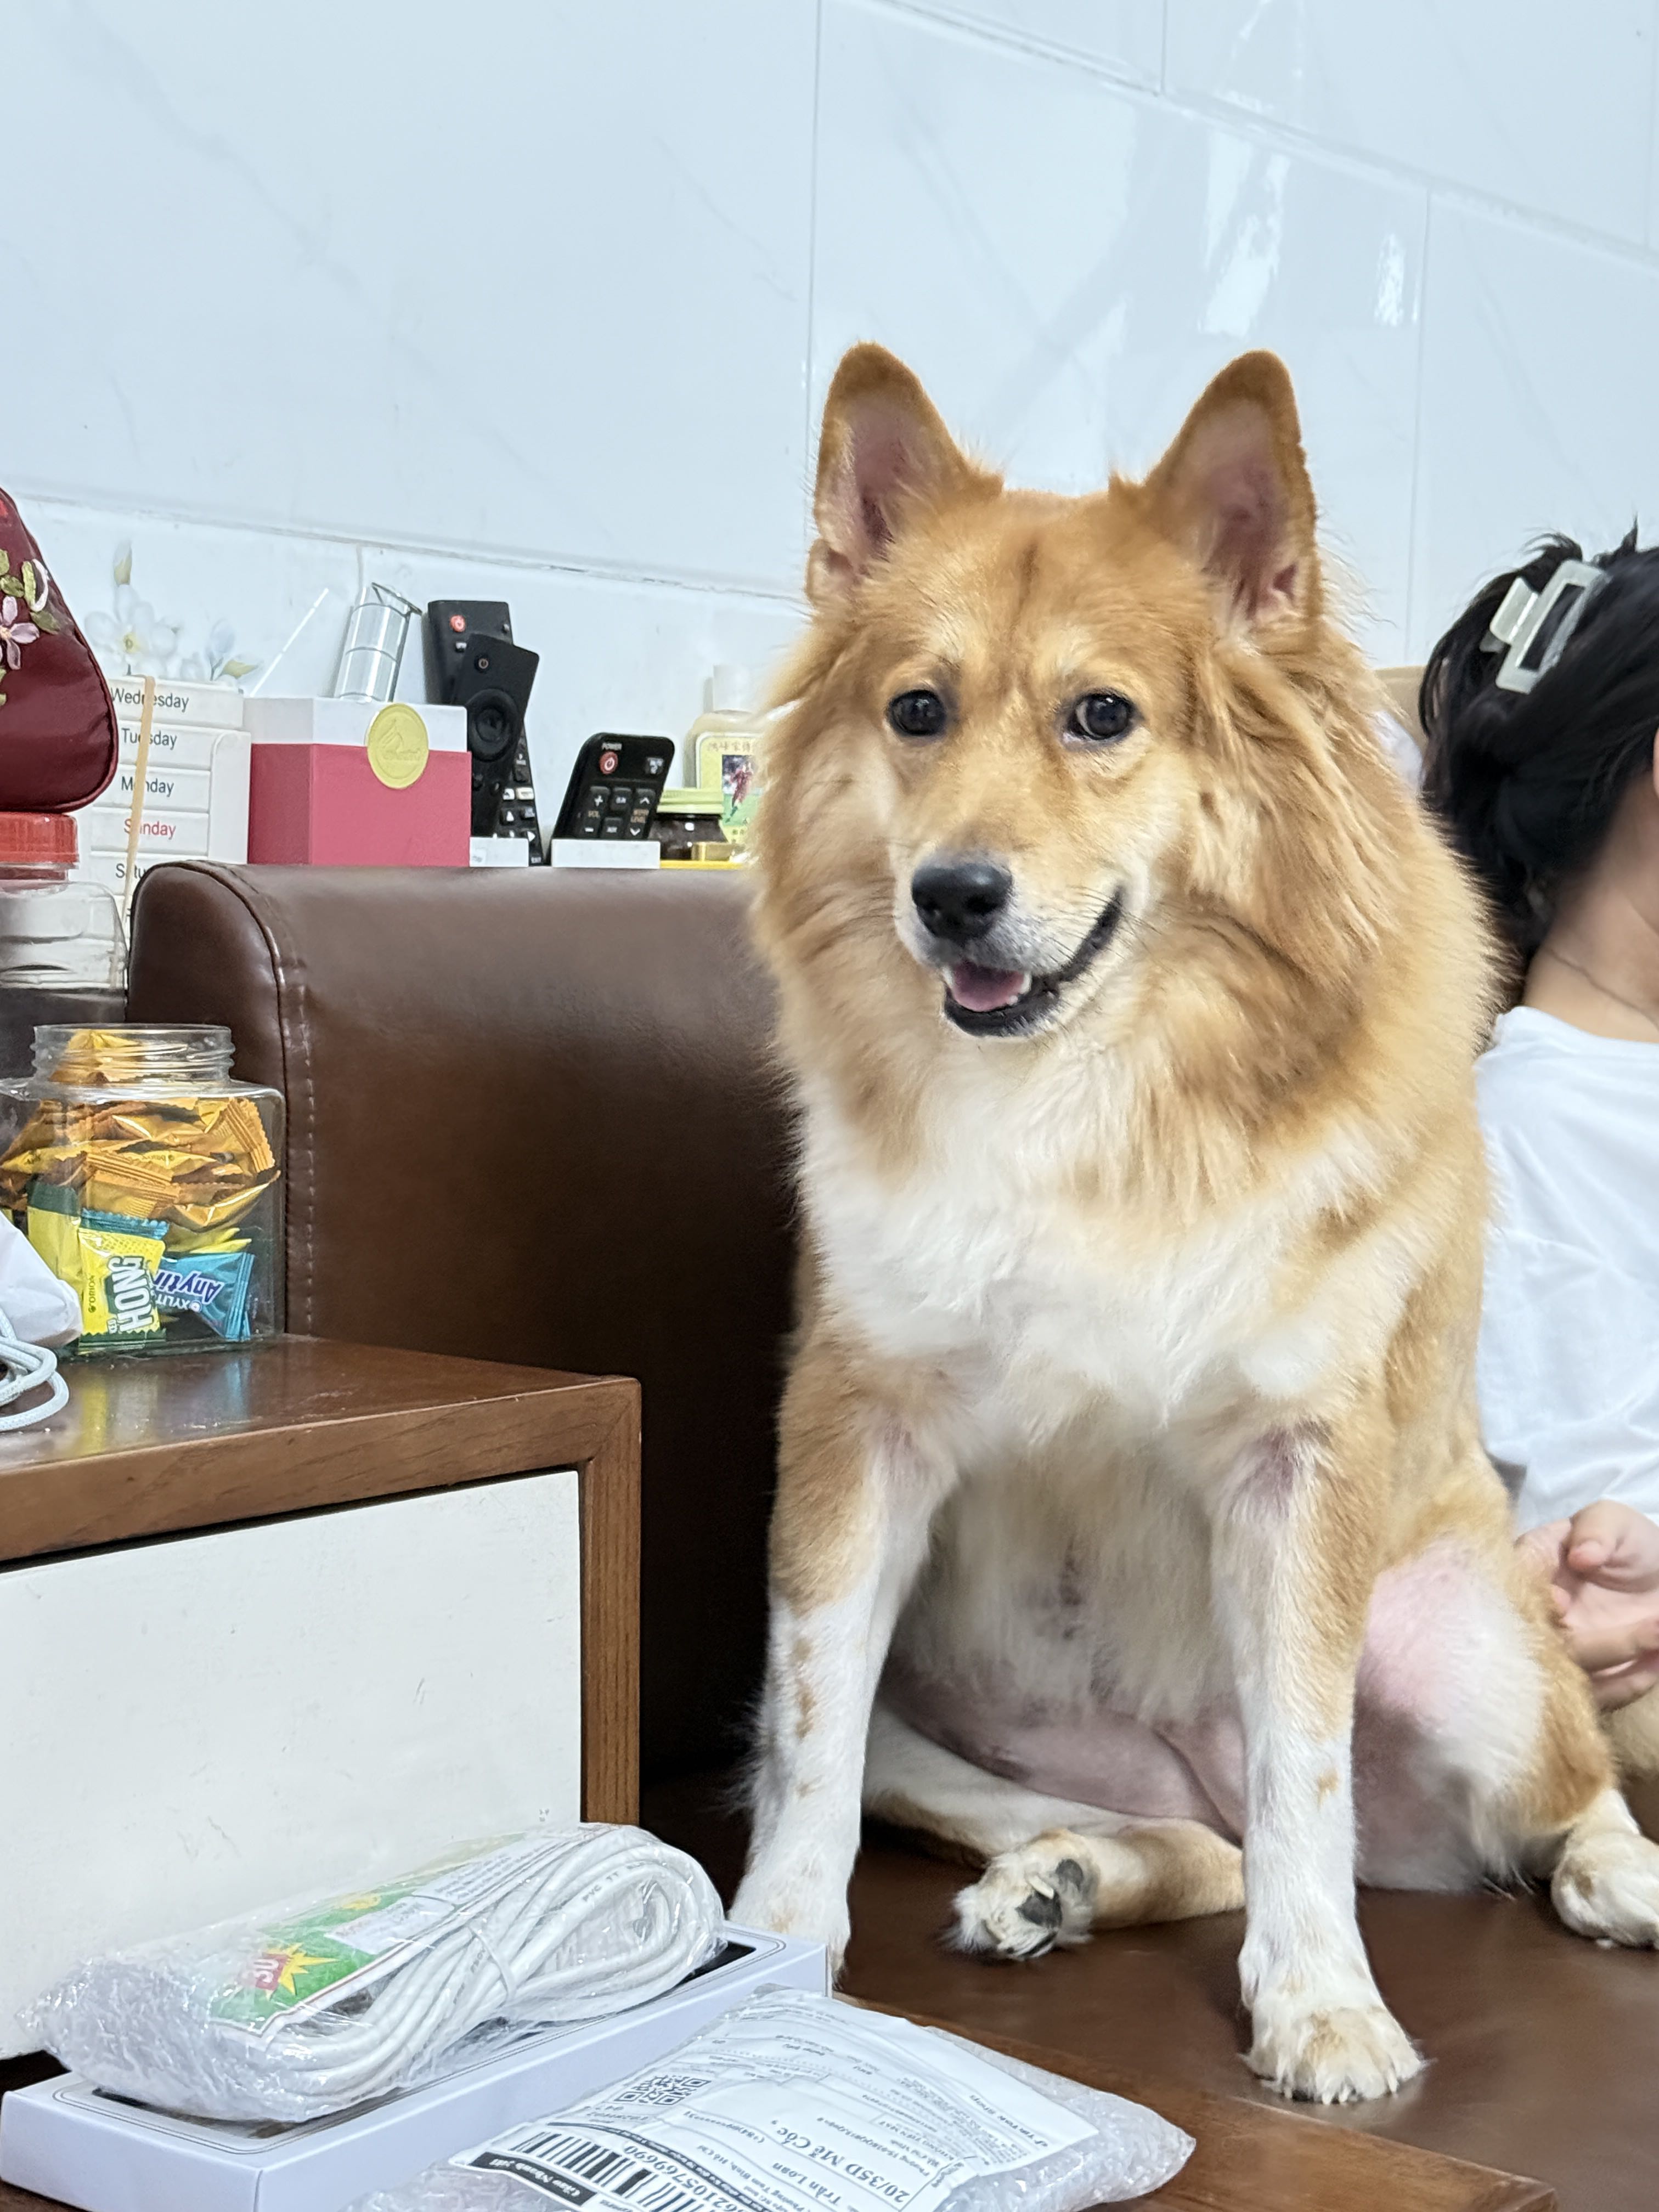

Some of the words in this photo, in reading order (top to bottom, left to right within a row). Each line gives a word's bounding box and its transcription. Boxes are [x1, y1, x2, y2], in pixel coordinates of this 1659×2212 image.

[121, 727, 178, 751] Tusday
[121, 775, 175, 798] Mnday
[123, 818, 176, 840] Snday
[153, 1270, 224, 1305] Anyti
[776, 2127, 811, 2149] Cốc
[624, 2145, 744, 2212] 62105769690
[772, 2163, 808, 2185] Loan
[845, 2163, 910, 2203] 20/35D
